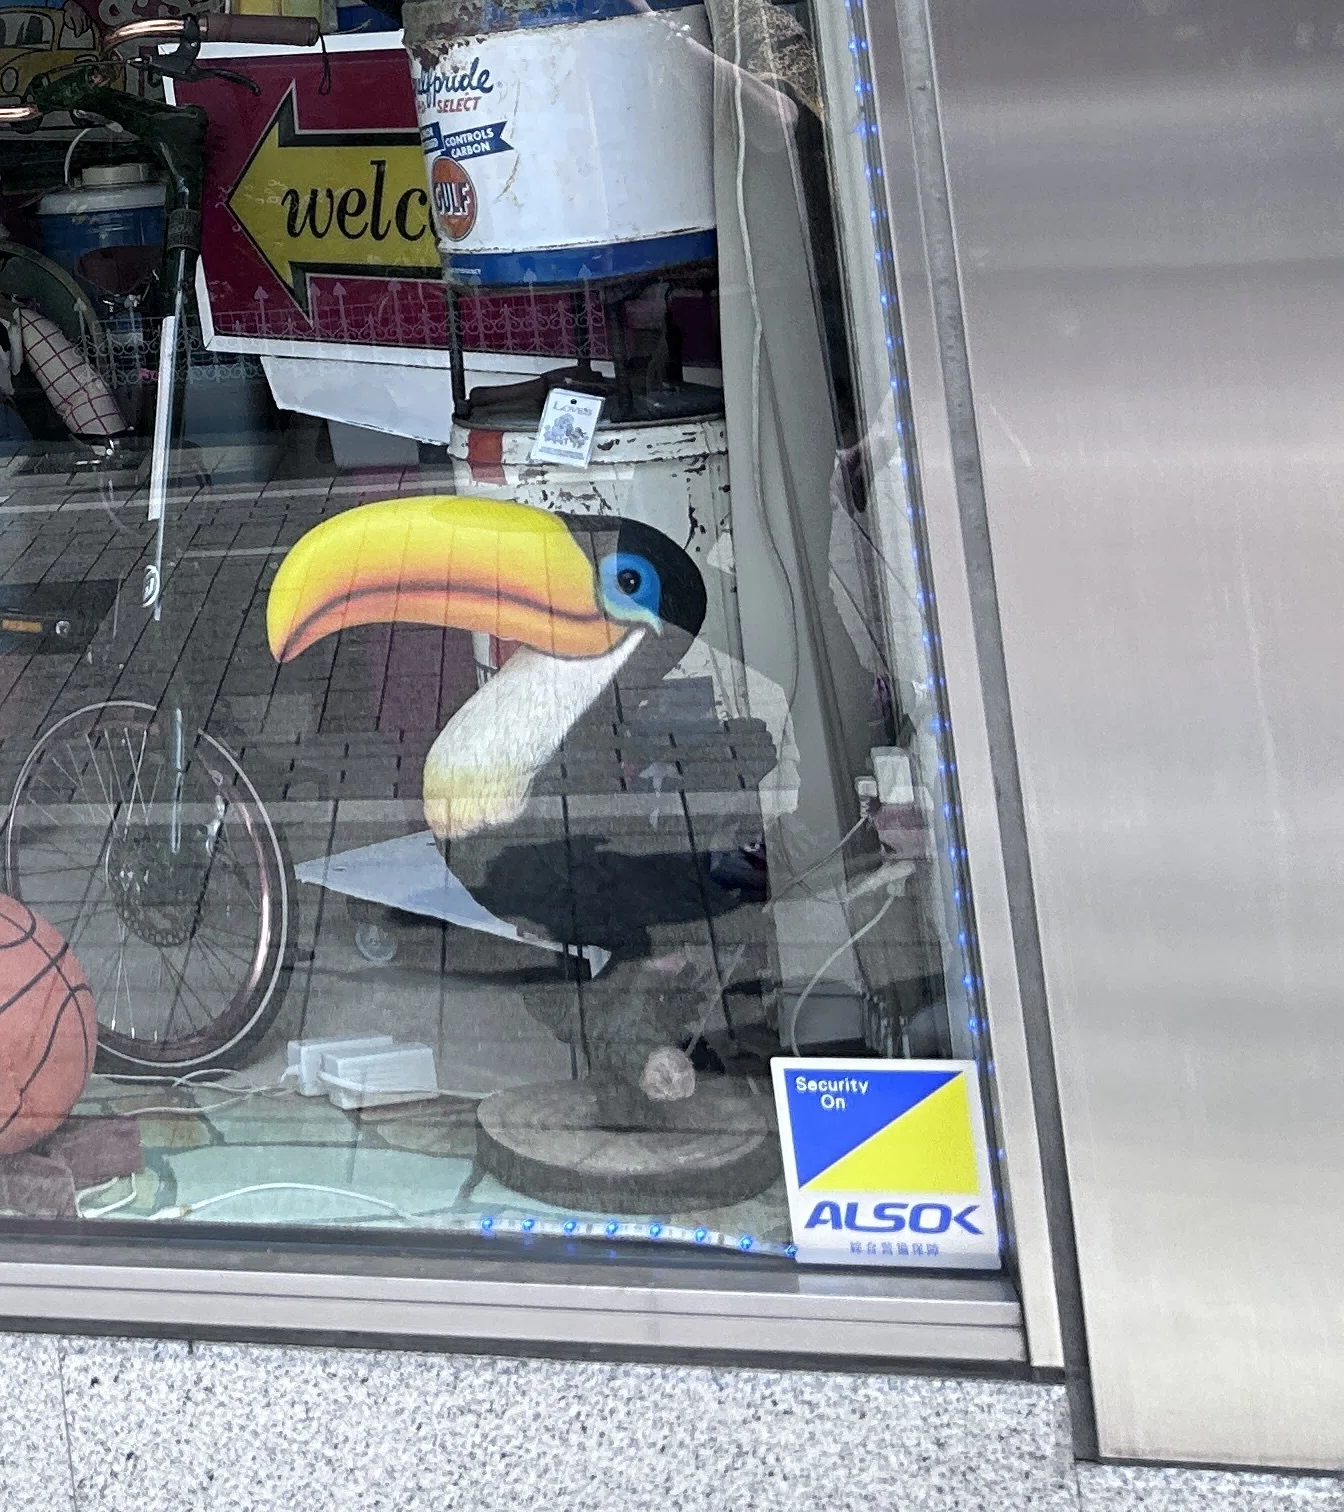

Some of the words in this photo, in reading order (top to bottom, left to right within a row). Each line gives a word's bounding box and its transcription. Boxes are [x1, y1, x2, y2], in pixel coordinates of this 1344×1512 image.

[436, 95, 482, 114] SELECT
[444, 127, 495, 149] CONTROLS
[451, 142, 491, 160] CARBON
[281, 160, 436, 241] welc
[435, 181, 472, 217] GULF
[796, 1076, 869, 1095] Security
[821, 1094, 846, 1110] On
[804, 1200, 984, 1235] ALSOK
